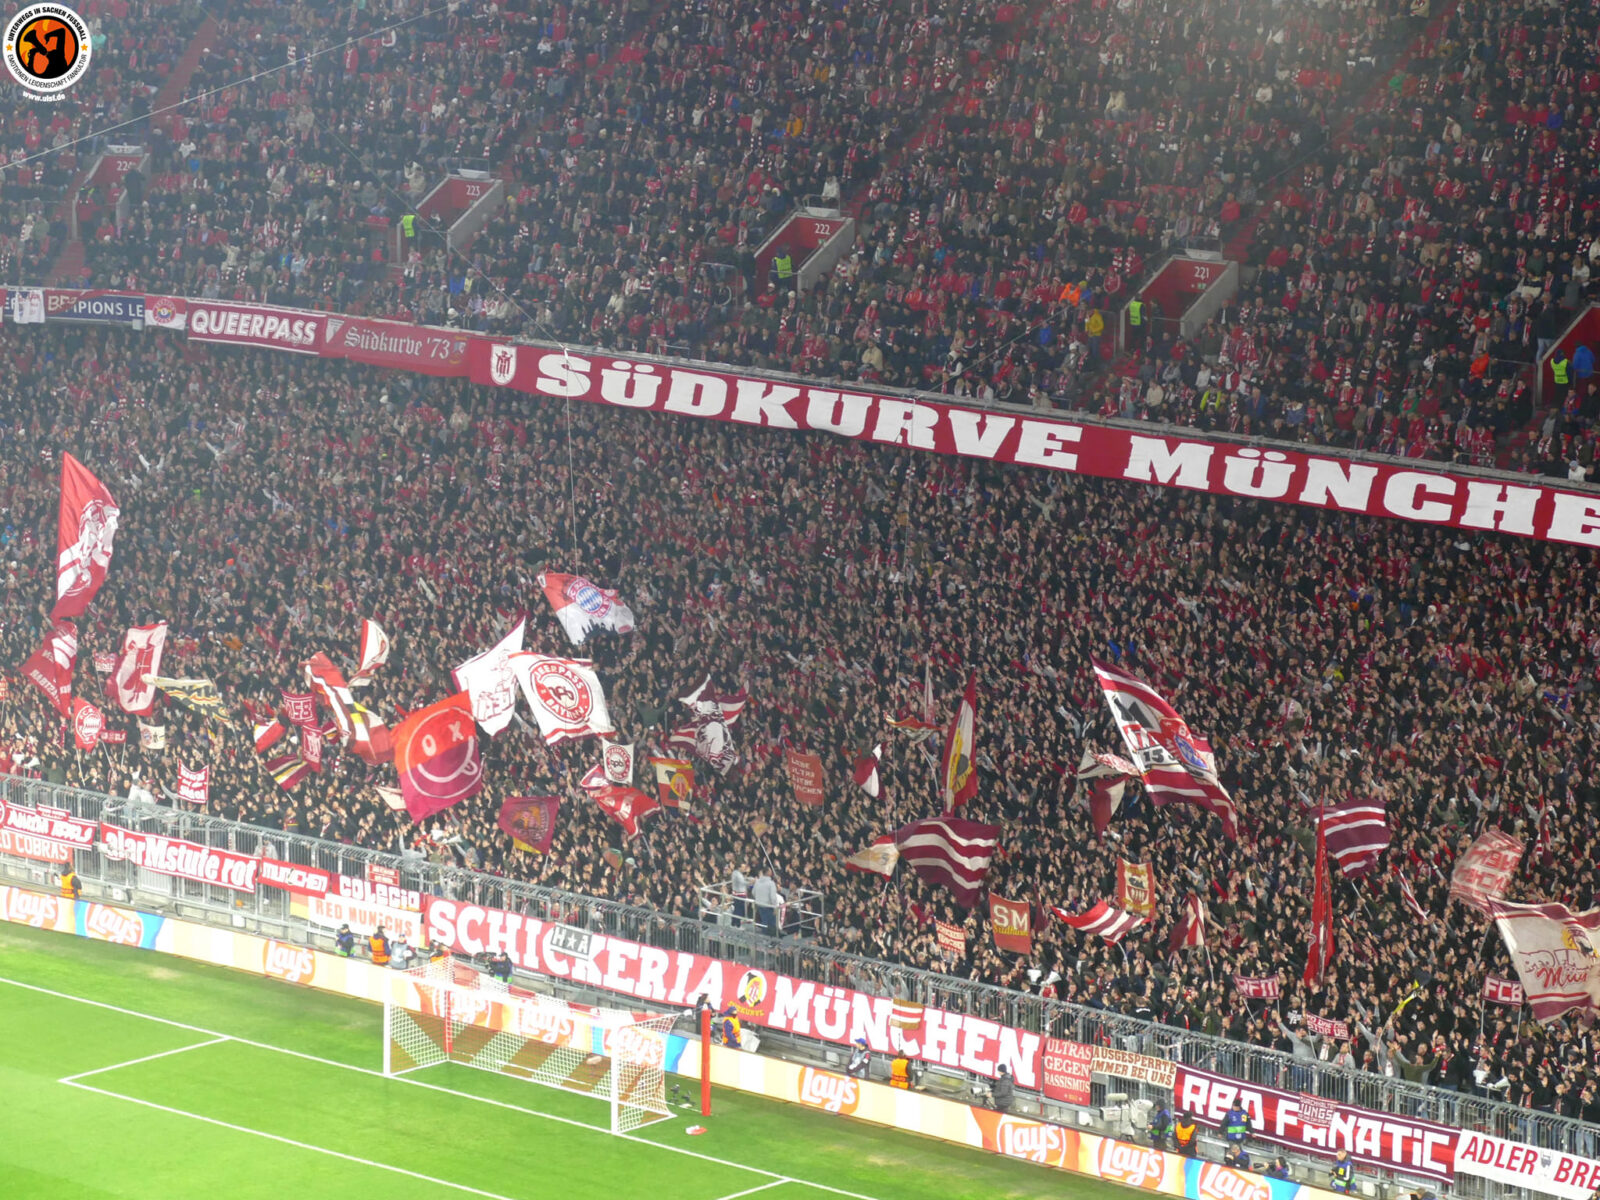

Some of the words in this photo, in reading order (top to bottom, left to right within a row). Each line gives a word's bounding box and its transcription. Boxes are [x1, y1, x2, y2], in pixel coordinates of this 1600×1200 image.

[466, 185, 480, 196] 223
[814, 223, 830, 235] 222
[1194, 266, 1209, 280] 221
[191, 309, 317, 345] QUEERPASS
[344, 326, 422, 356] Südkurve
[426, 337, 450, 360] '73
[536, 353, 1083, 471] SÜDKURVE
[16, 832, 69, 861] COBRAS
[221, 859, 257, 890] rot
[9, 887, 57, 928] Lay's
[316, 899, 343, 920] RED
[993, 904, 1028, 932] SM
[88, 902, 141, 946] Lay's
[266, 941, 314, 982] Lay's
[428, 900, 722, 1010] SCHICKERIA
[1484, 977, 1522, 1001] FCB
[1308, 1022, 1331, 1034] STOP
[1046, 1039, 1091, 1059] ULTRAS
[1092, 1046, 1176, 1073] AUSGESPERRTE
[1044, 1057, 1090, 1077] GEGEN
[1091, 1060, 1129, 1077] IMMER
[1131, 1065, 1148, 1079] BEI
[1150, 1070, 1172, 1086] UNS
[802, 1066, 859, 1112] Lay's
[1044, 1073, 1091, 1092] RASSISMUS
[1003, 1122, 1060, 1163] Lay's
[1461, 1136, 1539, 1175] ADLER
[1103, 1138, 1163, 1187] Lay's
[1203, 1163, 1270, 1200] Lay's
